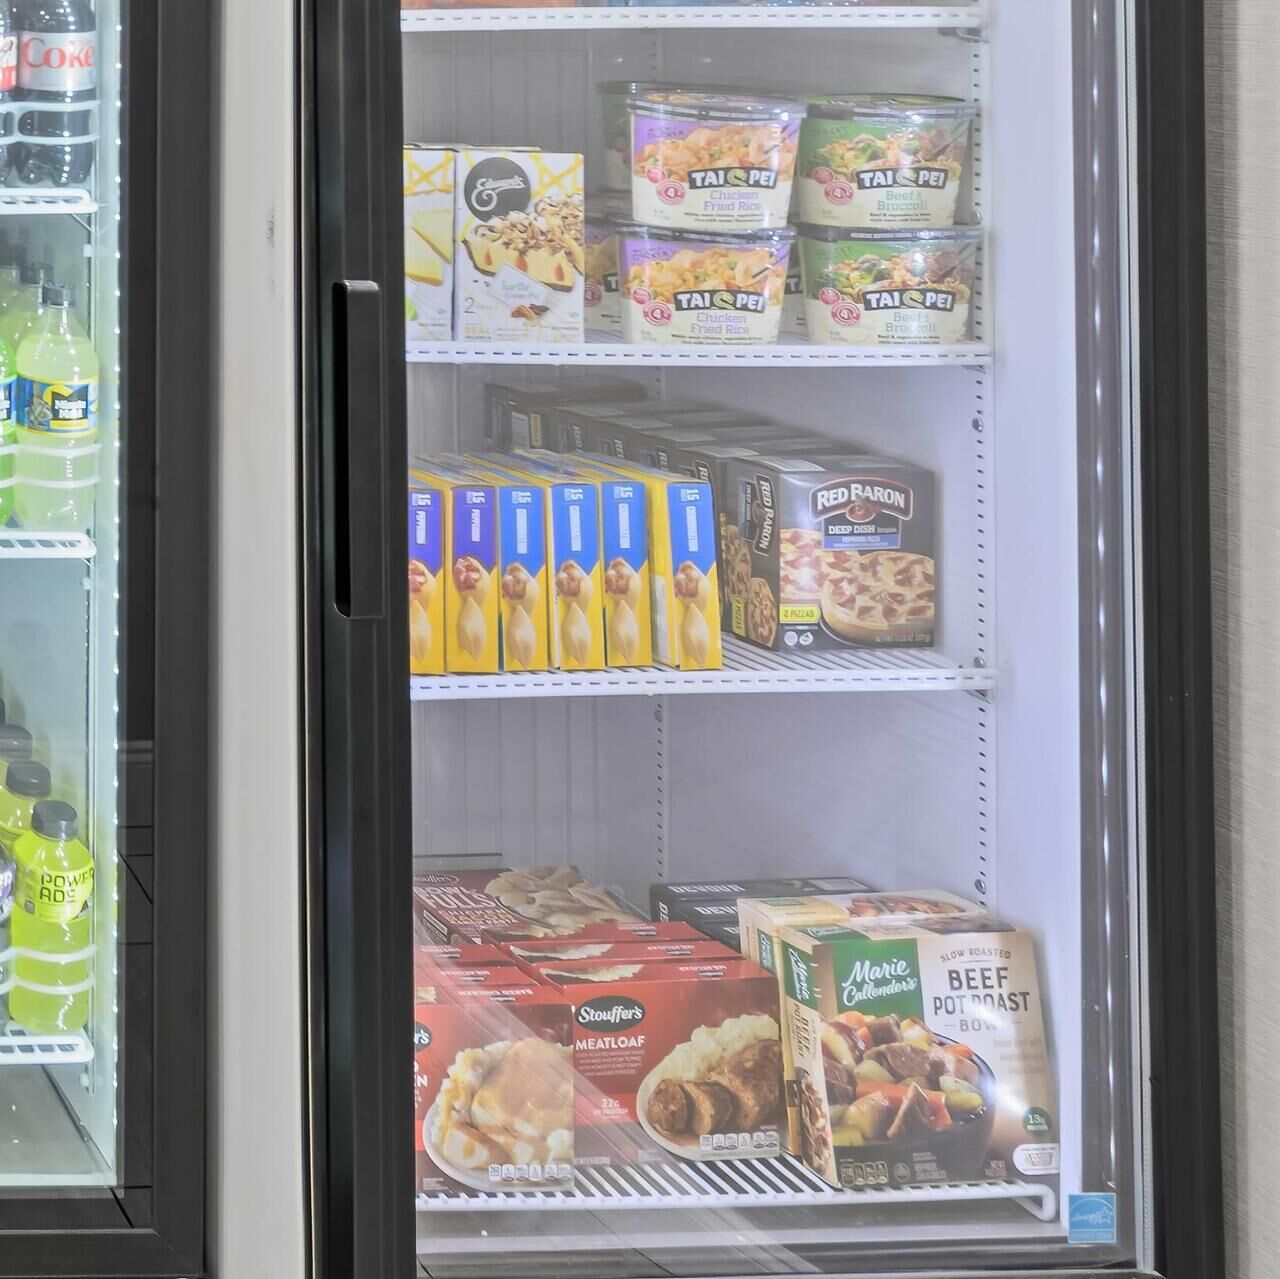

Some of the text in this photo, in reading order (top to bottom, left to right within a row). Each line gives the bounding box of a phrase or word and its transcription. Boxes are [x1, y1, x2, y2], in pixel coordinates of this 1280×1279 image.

[691, 170, 777, 187] TAI PEI
[859, 171, 946, 187] TAI PEI
[677, 293, 765, 310] TAI PEI
[866, 293, 953, 309] TAI PEI
[817, 483, 906, 511] RED BARON
[758, 480, 775, 550] RED BARON
[828, 525, 853, 534] DEEP
[853, 524, 876, 533] DISH
[790, 608, 815, 618] PIZZAS
[39, 886, 76, 904] ADE
[940, 947, 1013, 963] SLOW ROASTED
[842, 958, 911, 988] Marie
[947, 966, 1010, 991] BEEF
[842, 977, 918, 1008] Callender's
[933, 994, 967, 1016] POT
[578, 1005, 644, 1024] Stouffer's
[958, 1018, 998, 1033] BOW
[575, 1035, 646, 1051] MEATLOAF
